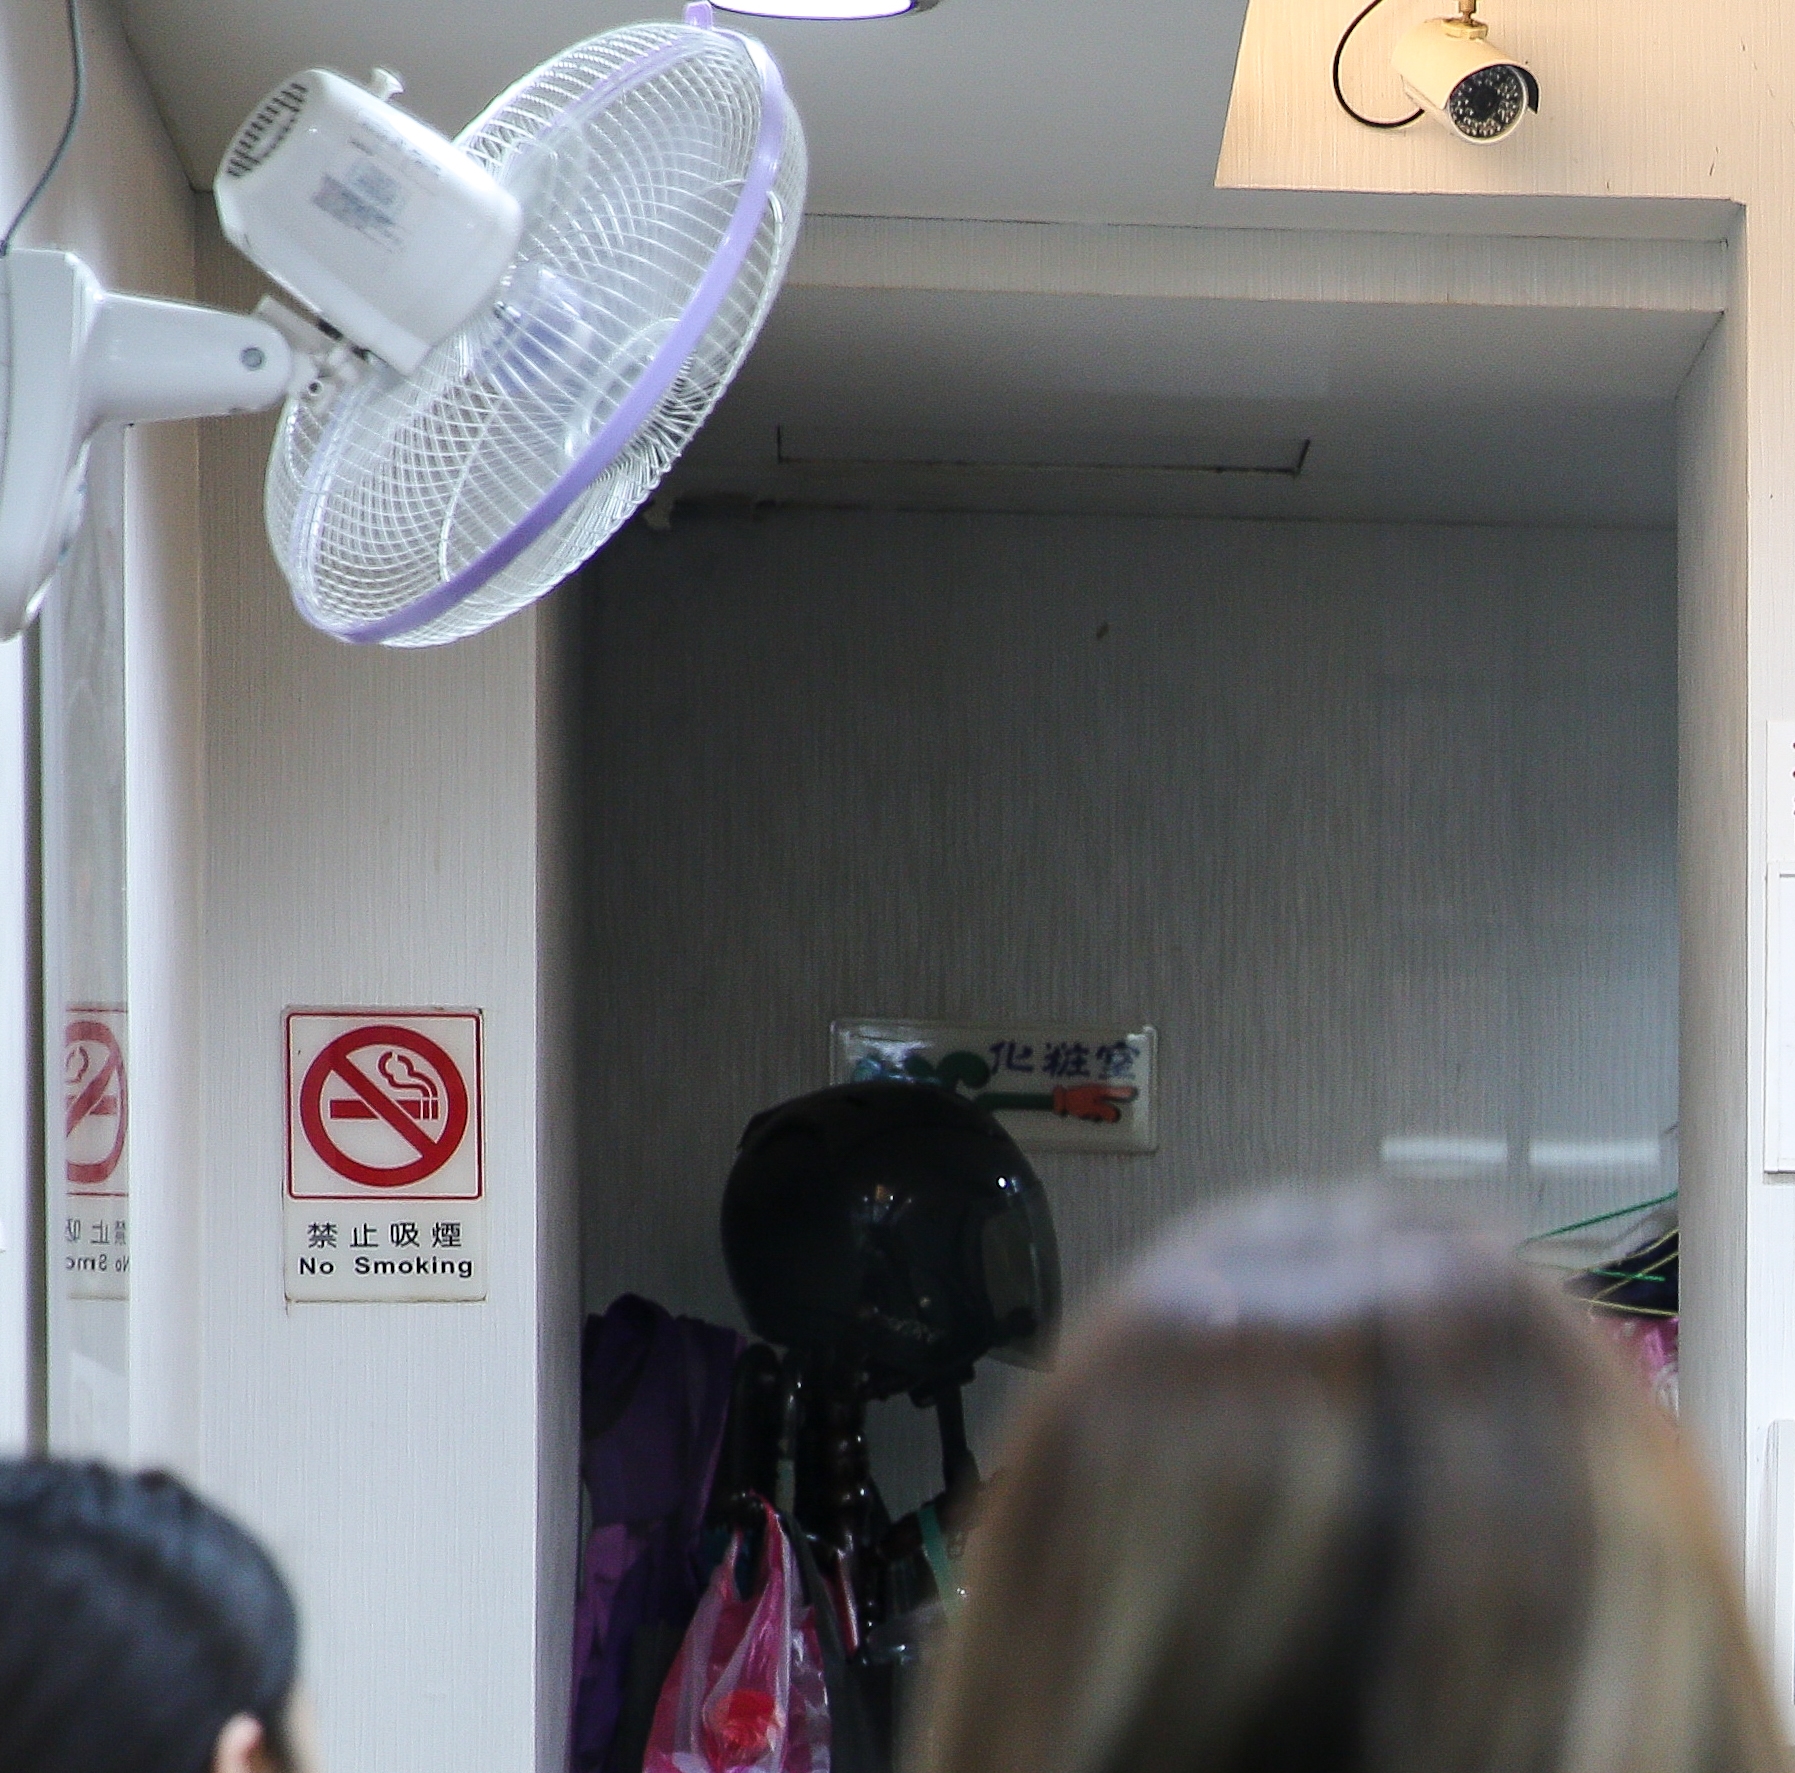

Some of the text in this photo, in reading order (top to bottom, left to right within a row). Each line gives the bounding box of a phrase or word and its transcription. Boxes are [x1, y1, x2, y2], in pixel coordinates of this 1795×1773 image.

[307, 1222, 463, 1249] 禁止吸煙
[299, 1255, 473, 1279] No Smoking
